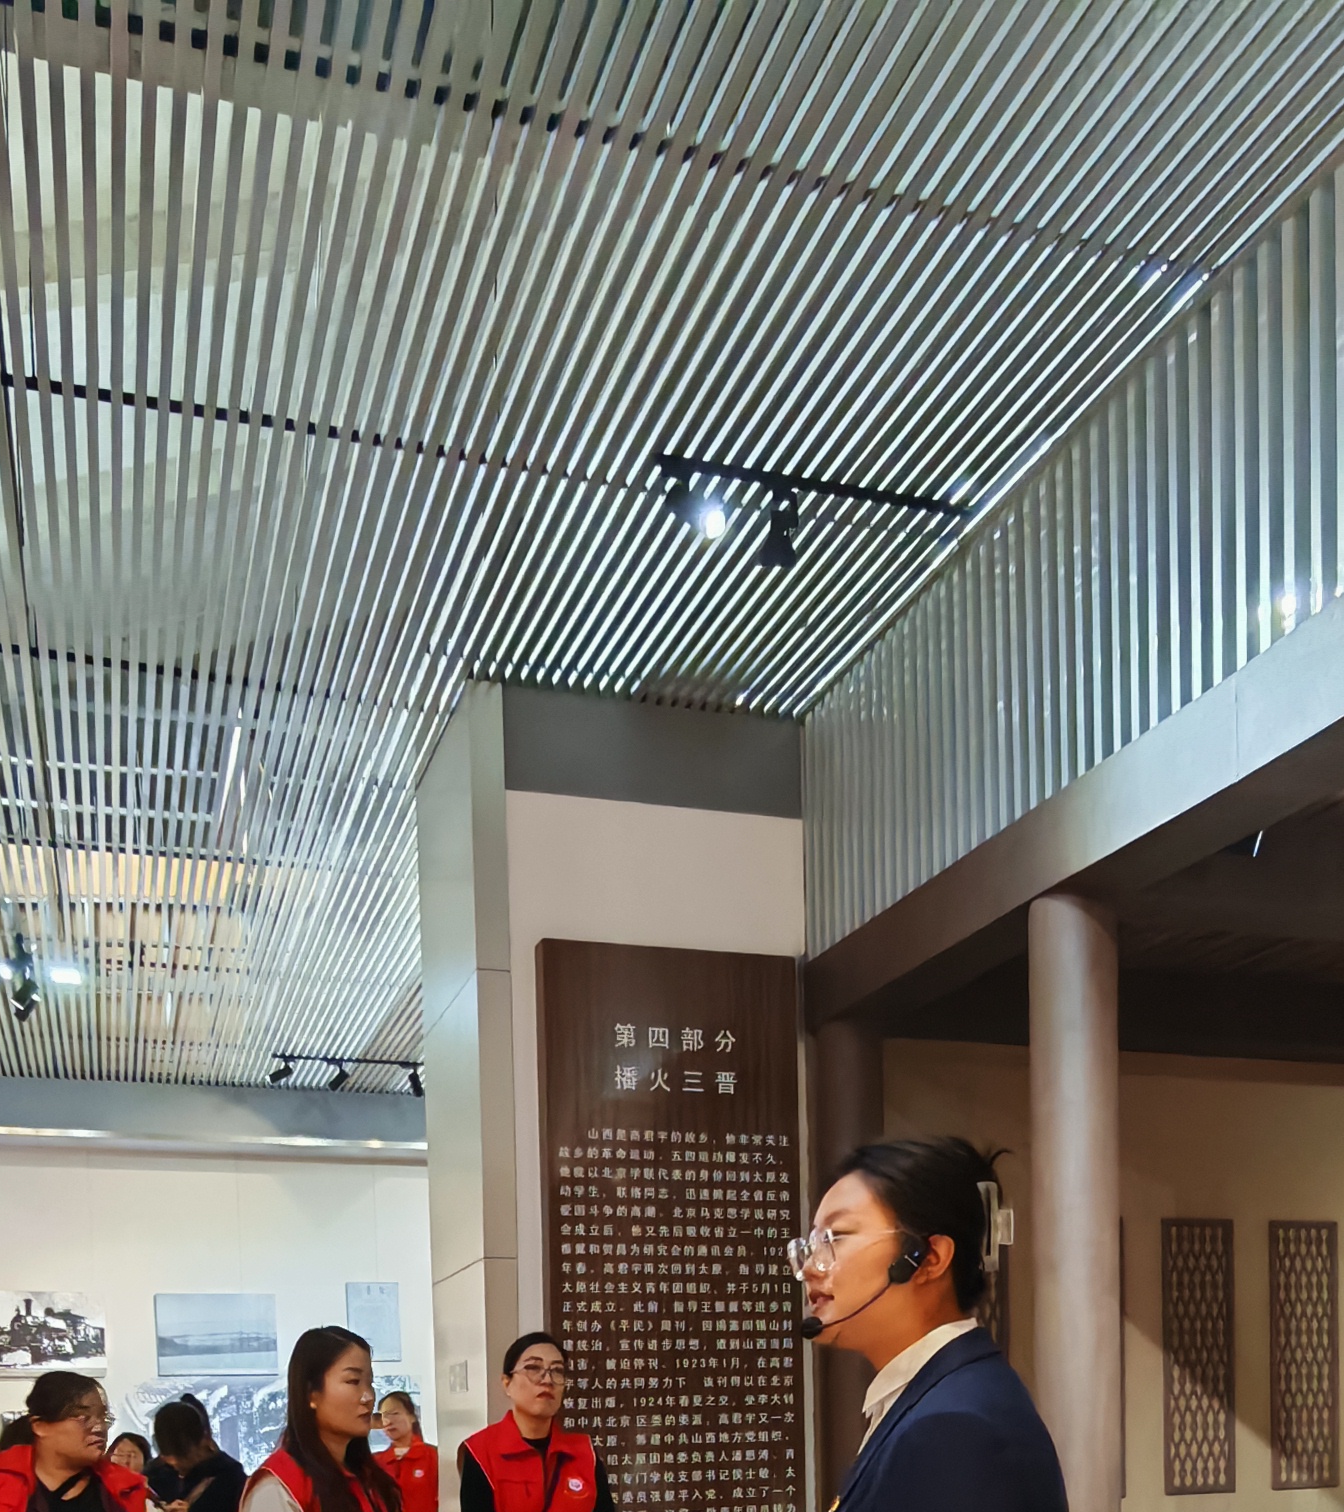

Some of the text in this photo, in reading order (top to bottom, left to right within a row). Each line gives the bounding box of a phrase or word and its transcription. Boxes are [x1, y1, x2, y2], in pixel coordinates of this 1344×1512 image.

[614, 1023, 736, 1053] 第四部分
[614, 1065, 738, 1095] 播火三晋
